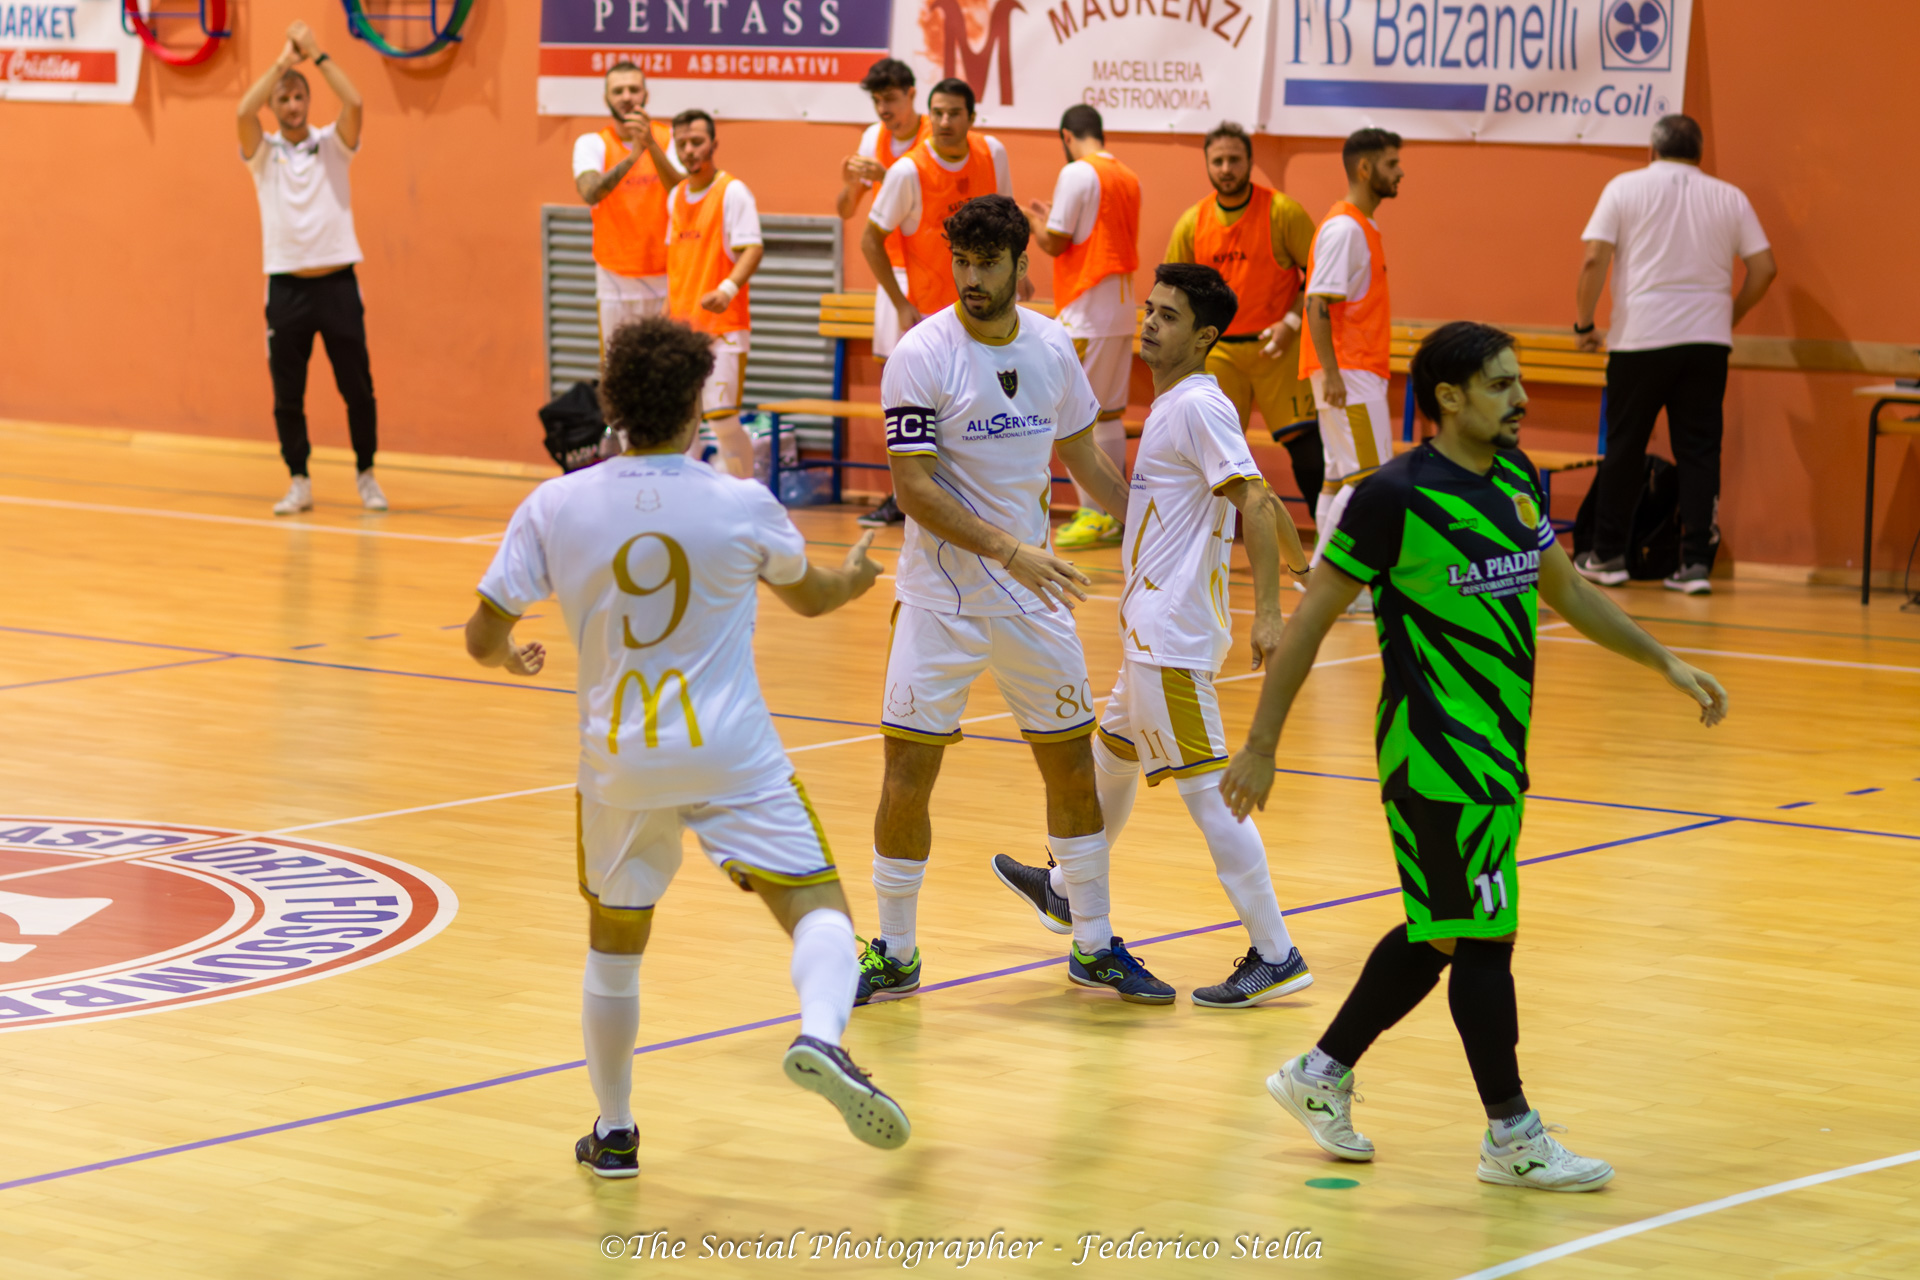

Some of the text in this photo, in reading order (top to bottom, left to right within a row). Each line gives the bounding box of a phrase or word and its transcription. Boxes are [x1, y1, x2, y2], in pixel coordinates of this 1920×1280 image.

[0, 5, 76, 39] ARKET
[593, 0, 841, 35] PENTASS
[1374, 0, 1578, 71] Balzanelli
[687, 54, 840, 75] ASSICURATIVI
[1092, 60, 1204, 83] MACELLERIA
[1081, 86, 1212, 110] GASTRONOMIA
[901, 414, 922, 437] C
[612, 531, 691, 649] 9
[1448, 562, 1482, 584] LA
[1056, 677, 1093, 719] 80
[1474, 869, 1508, 914] 11
